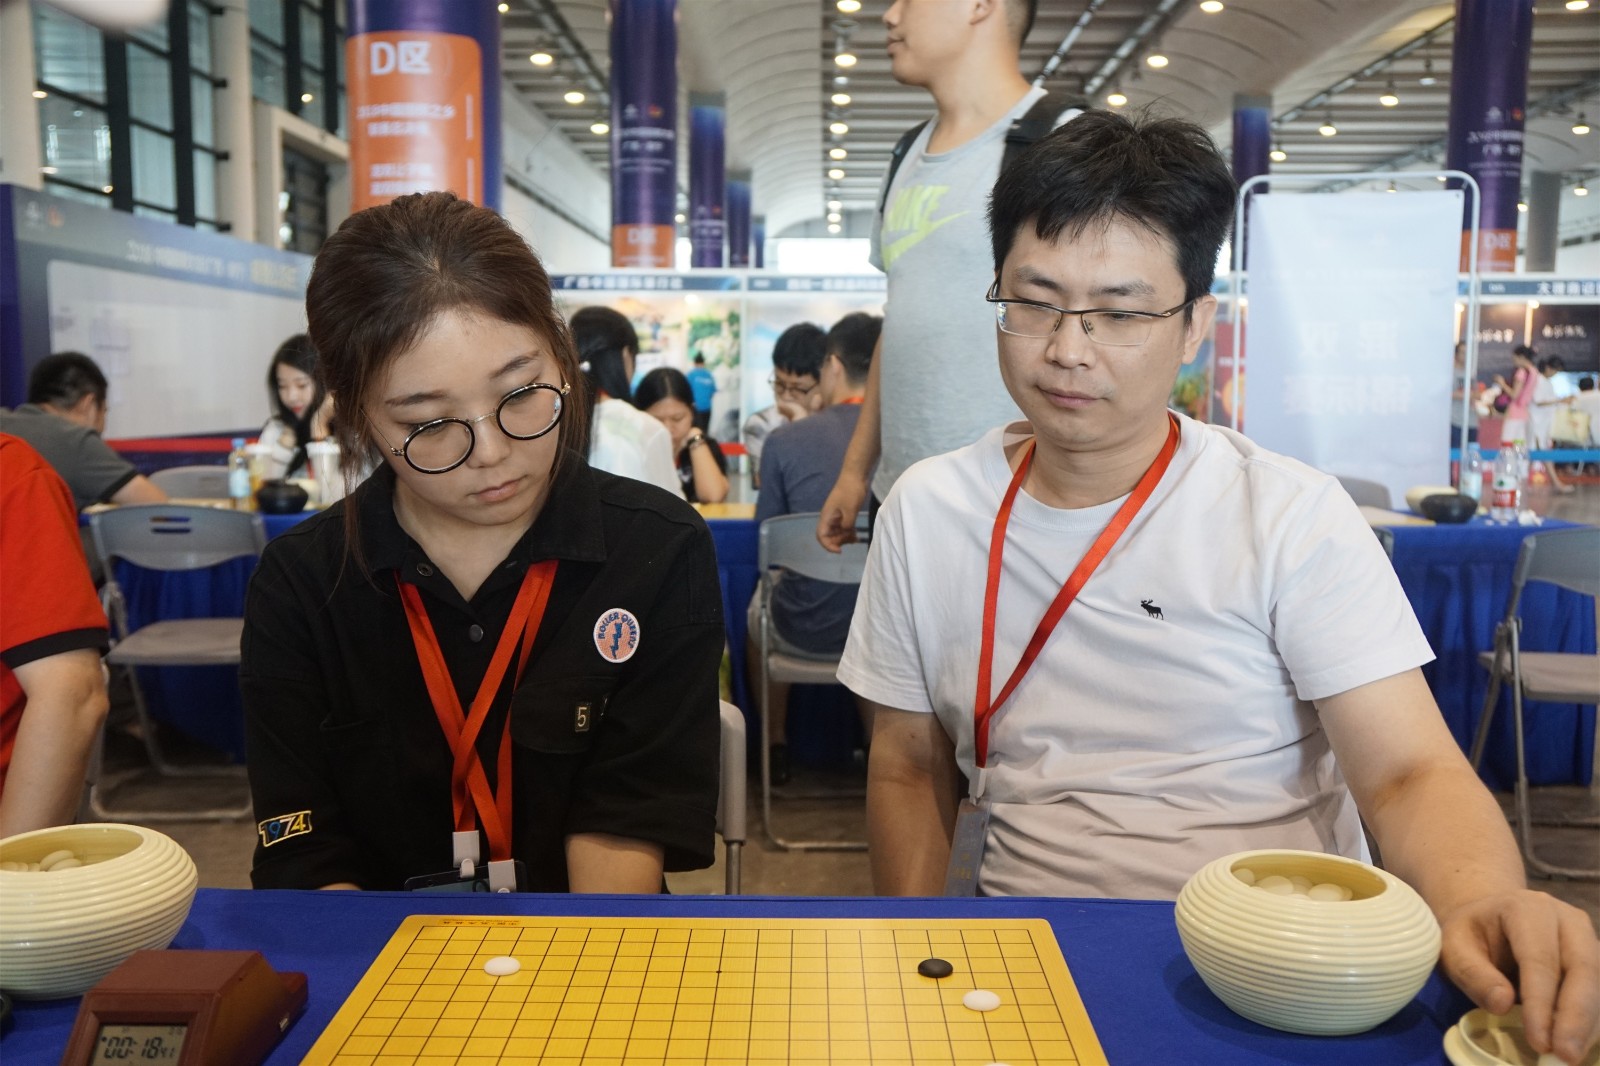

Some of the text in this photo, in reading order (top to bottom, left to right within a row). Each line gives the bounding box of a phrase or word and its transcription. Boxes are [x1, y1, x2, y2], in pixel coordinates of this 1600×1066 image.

[370, 41, 432, 75] D区
[598, 611, 637, 649] ROLLER QUEENS
[577, 706, 588, 728] 5
[259, 812, 307, 846] 1974
